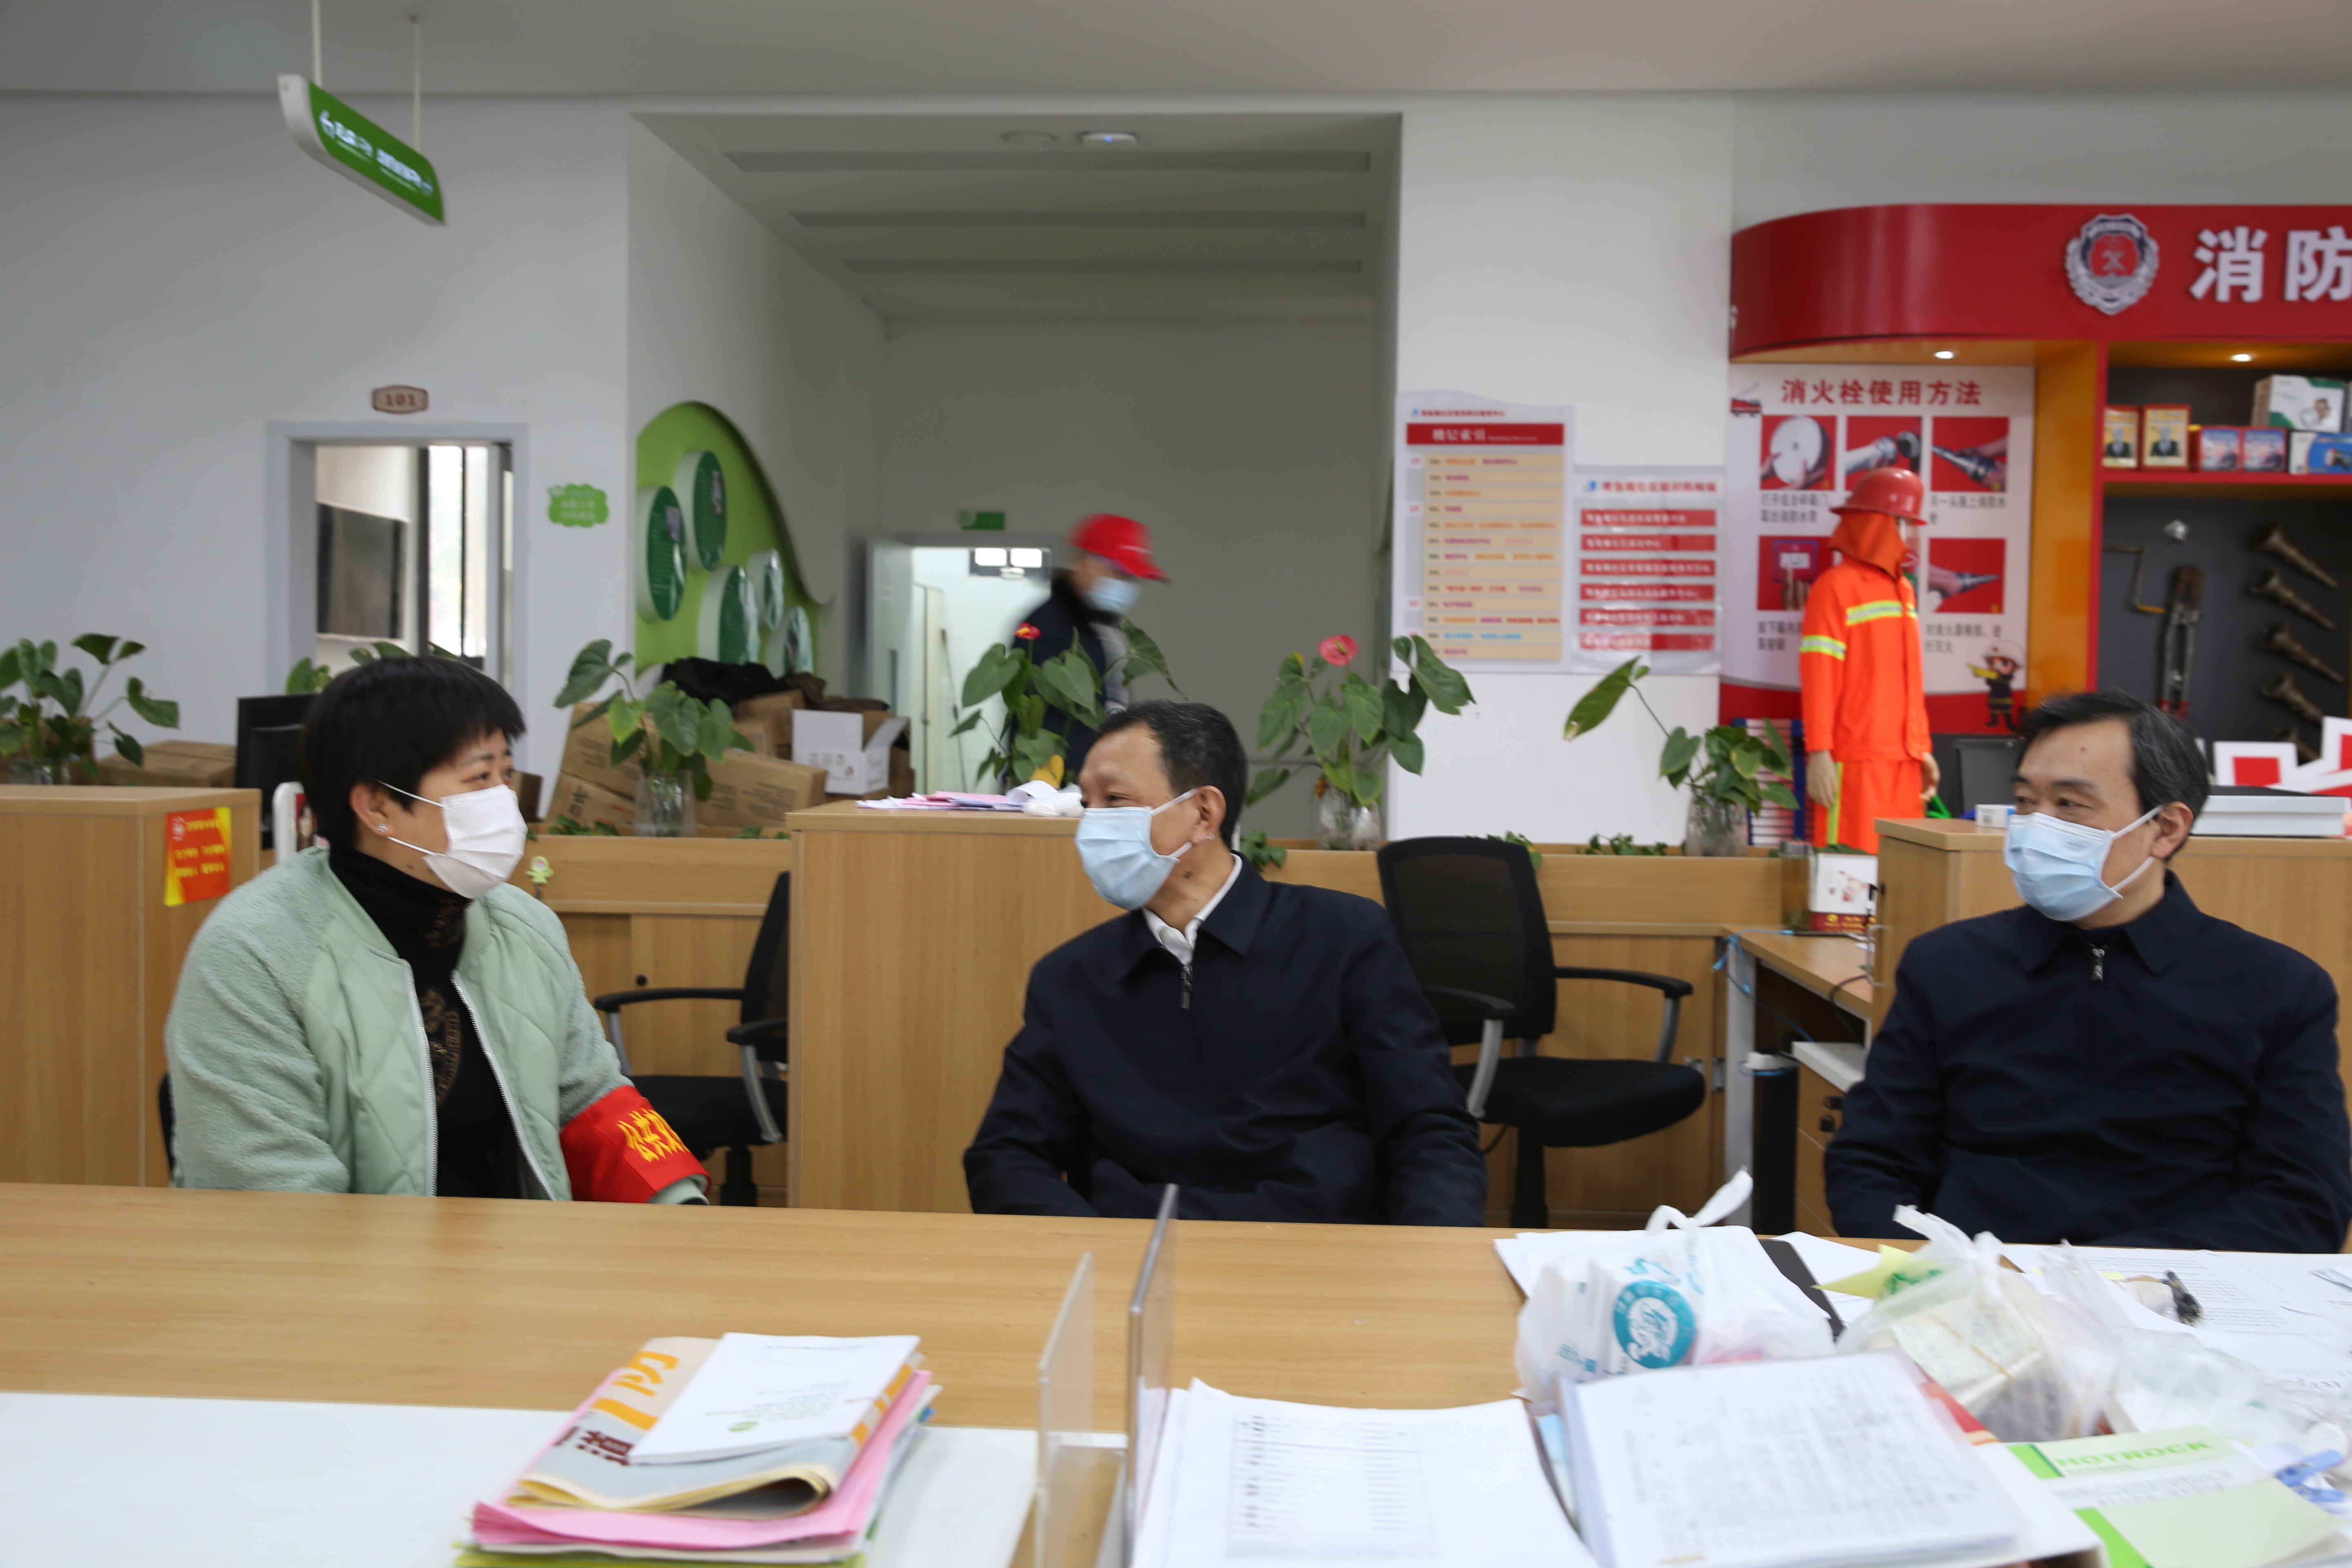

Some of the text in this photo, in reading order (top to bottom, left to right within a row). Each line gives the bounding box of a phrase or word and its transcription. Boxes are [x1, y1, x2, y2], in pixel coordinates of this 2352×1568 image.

[2189, 225, 2352, 303] 消防
[385, 394, 416, 406] 101
[1781, 378, 1981, 405] 消火栓使用方法
[616, 1107, 691, 1163] 公共文
[2056, 1440, 2212, 1467] HOTROCK
